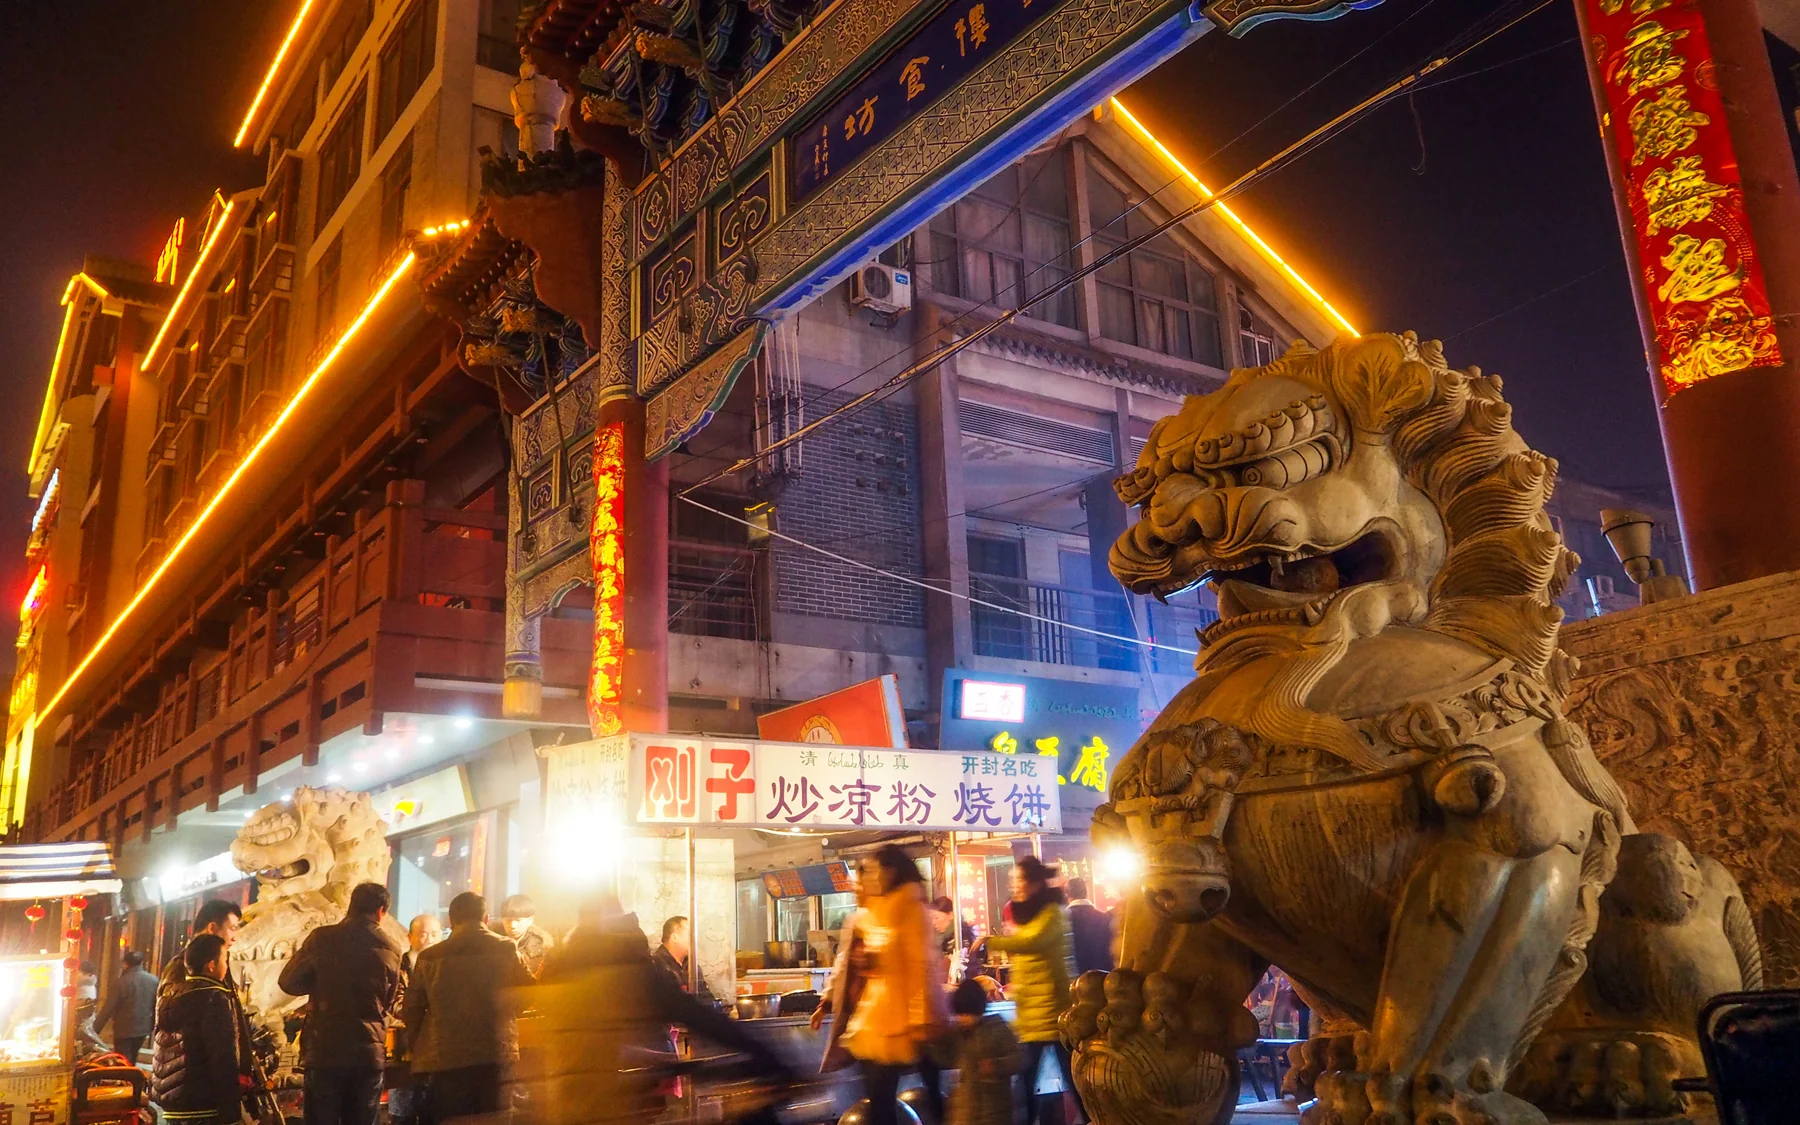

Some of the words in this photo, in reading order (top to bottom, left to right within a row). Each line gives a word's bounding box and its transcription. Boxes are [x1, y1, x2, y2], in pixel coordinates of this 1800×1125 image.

[799, 750, 818, 767] 清
[892, 753, 910, 771] 真
[960, 755, 1039, 778] 开封名吃
[765, 775, 937, 826] 炒凉粉
[952, 782, 1052, 828] 烧饼
